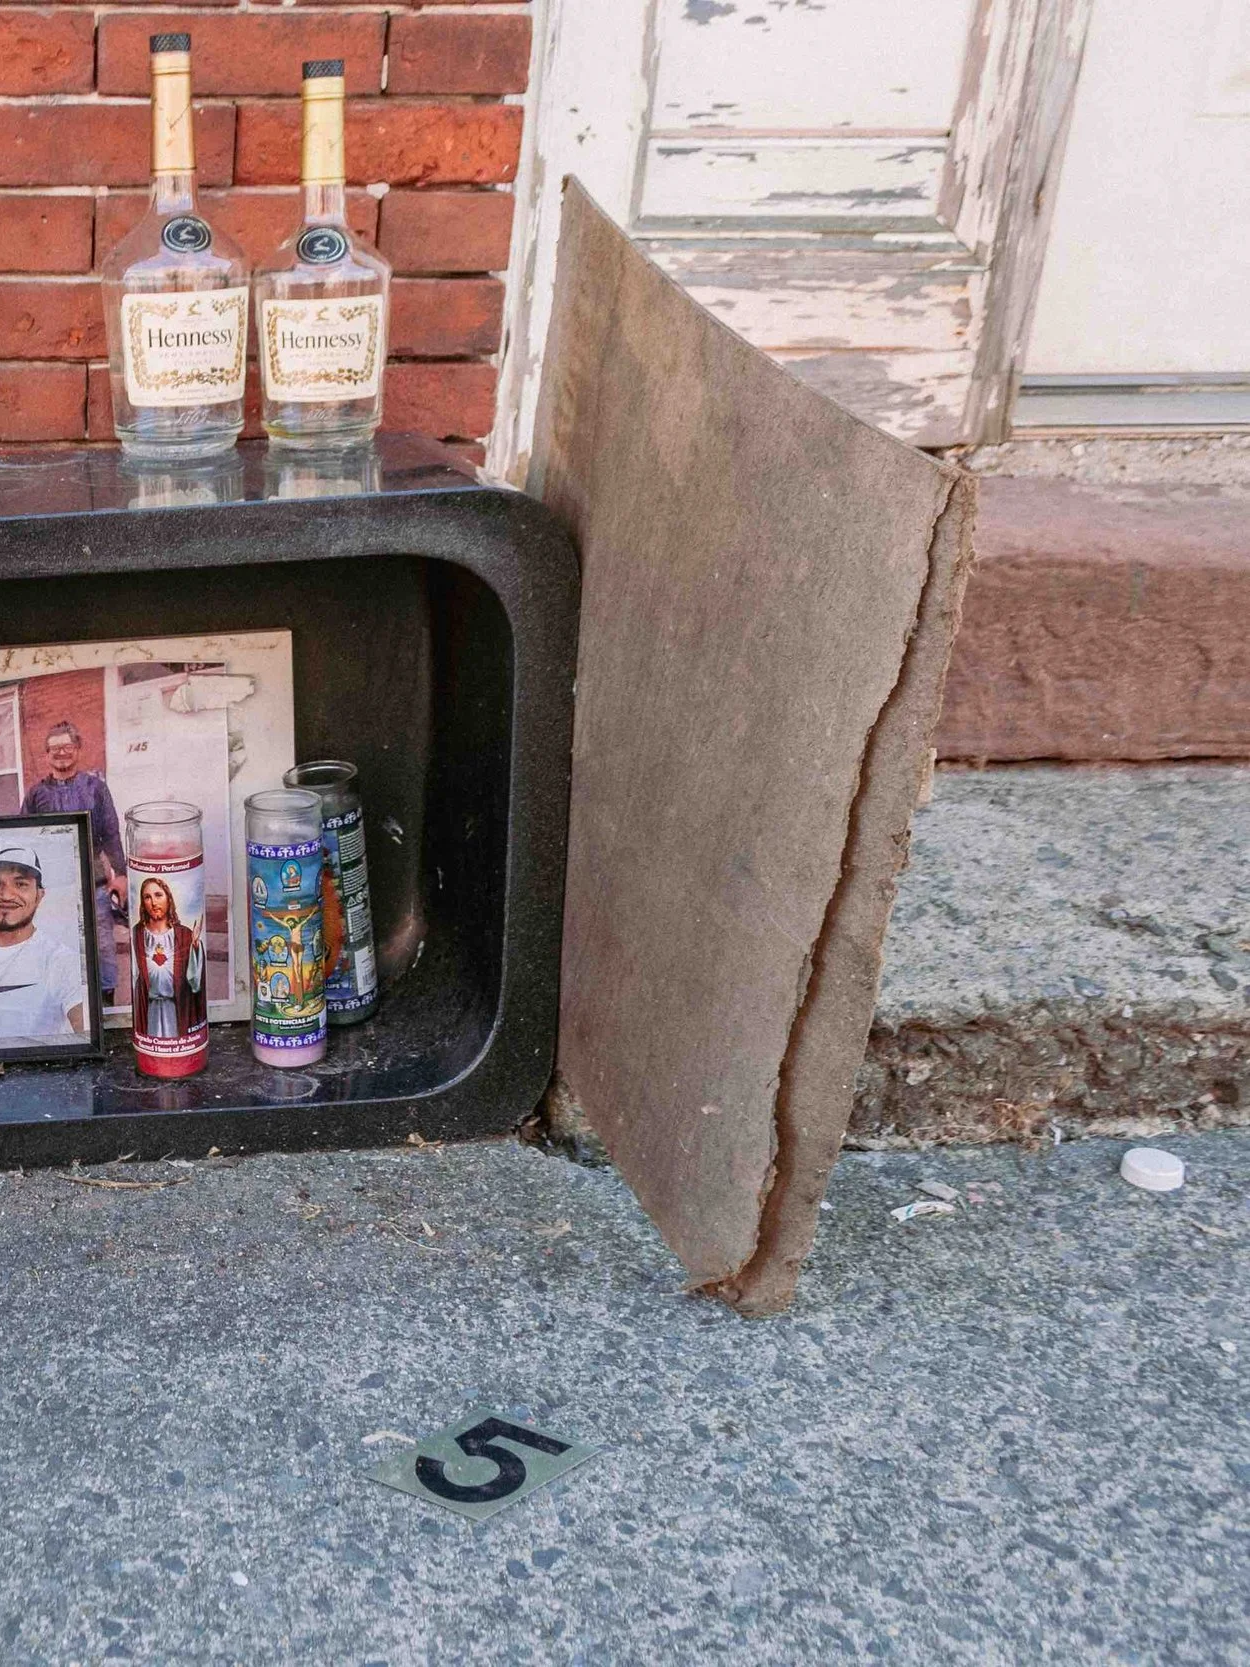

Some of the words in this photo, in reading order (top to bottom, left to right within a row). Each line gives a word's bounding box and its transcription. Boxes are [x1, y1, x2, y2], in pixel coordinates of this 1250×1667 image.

[147, 327, 235, 349] Hennessy
[281, 331, 365, 350] Hennessy
[415, 1416, 574, 1503] 5
